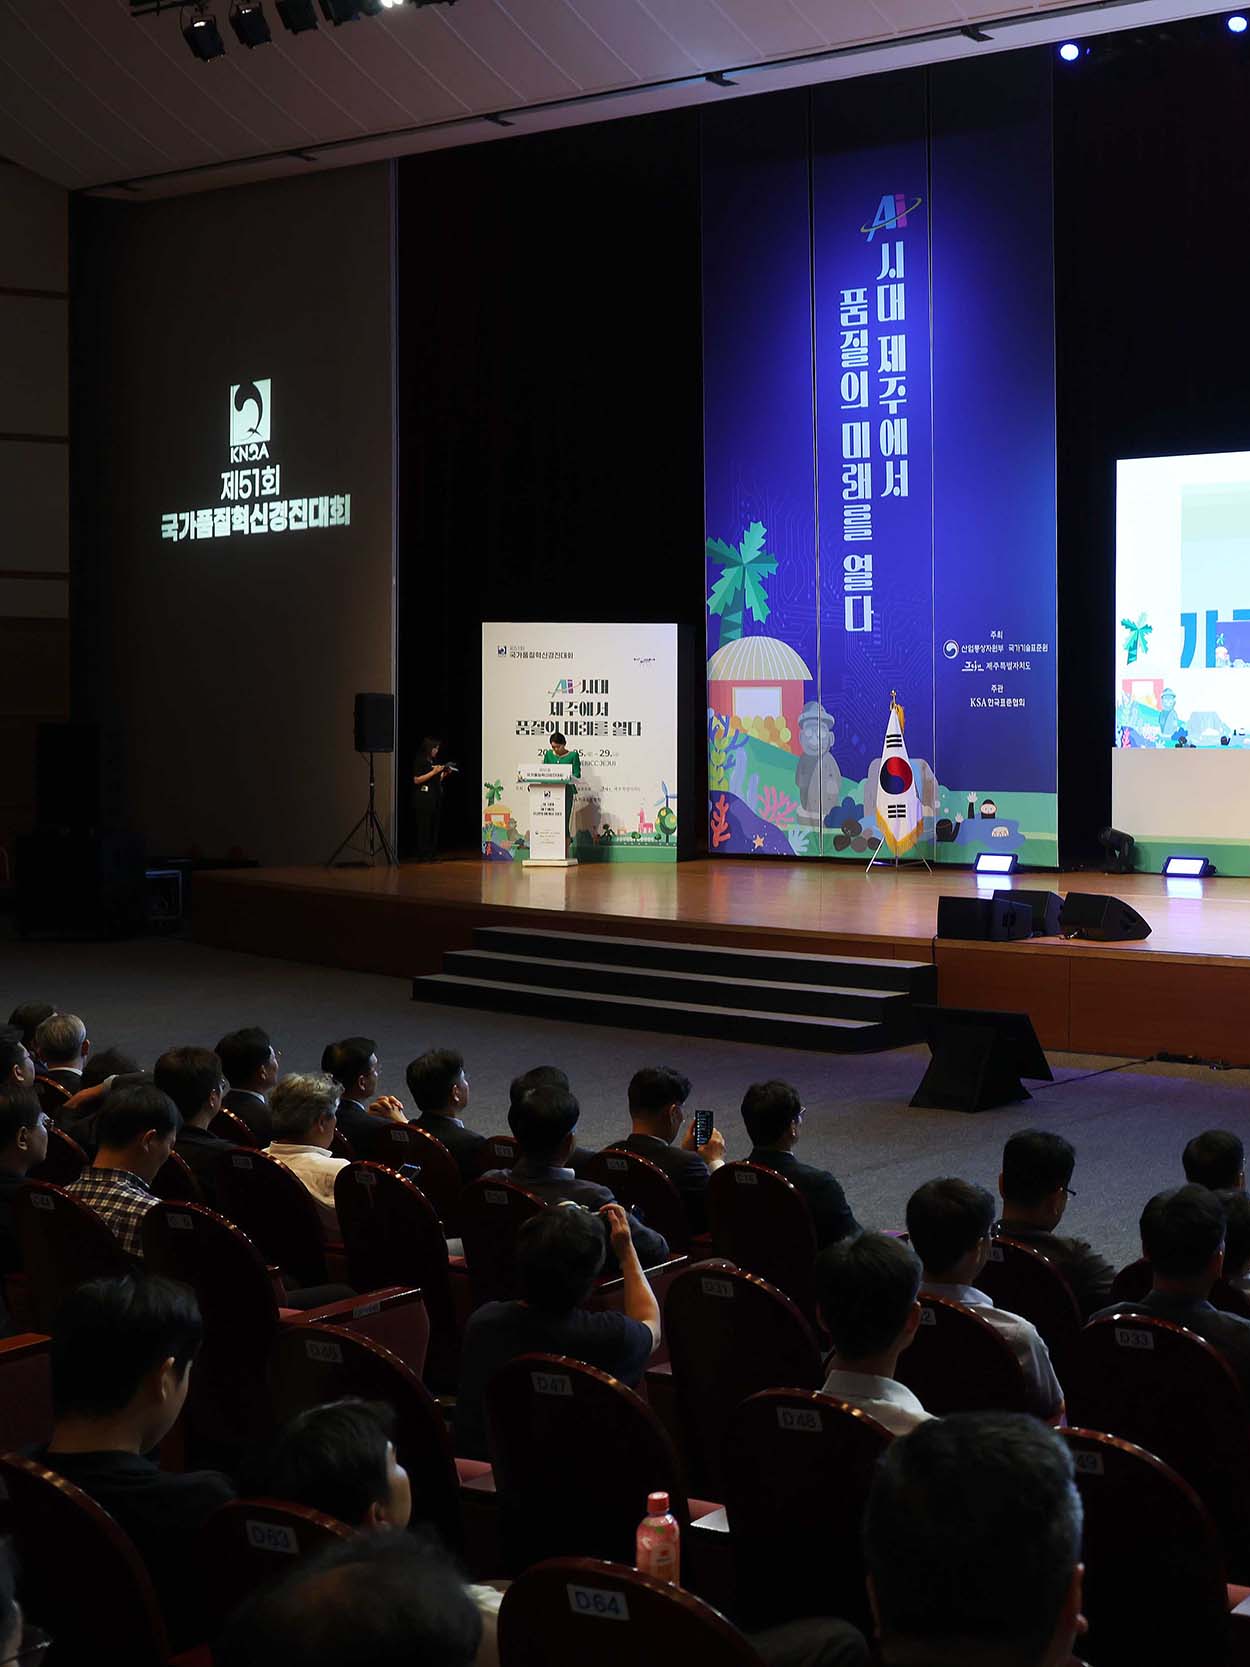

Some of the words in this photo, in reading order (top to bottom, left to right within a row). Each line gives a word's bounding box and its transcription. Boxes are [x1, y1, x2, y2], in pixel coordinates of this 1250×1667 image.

[876, 241, 906, 322] 시대
[839, 288, 869, 410] 품질의
[877, 334, 909, 497] 제주에서
[230, 442, 270, 463] KNQA
[221, 464, 280, 500] 제51회
[841, 421, 873, 541] 미래를
[161, 494, 351, 542] 국가품질혁신경진대회
[843, 554, 875, 632] 열다
[581, 679, 609, 694] 시대
[549, 701, 609, 717] 제주에서
[564, 720, 608, 737] 미래를
[574, 1590, 622, 1615] D64
